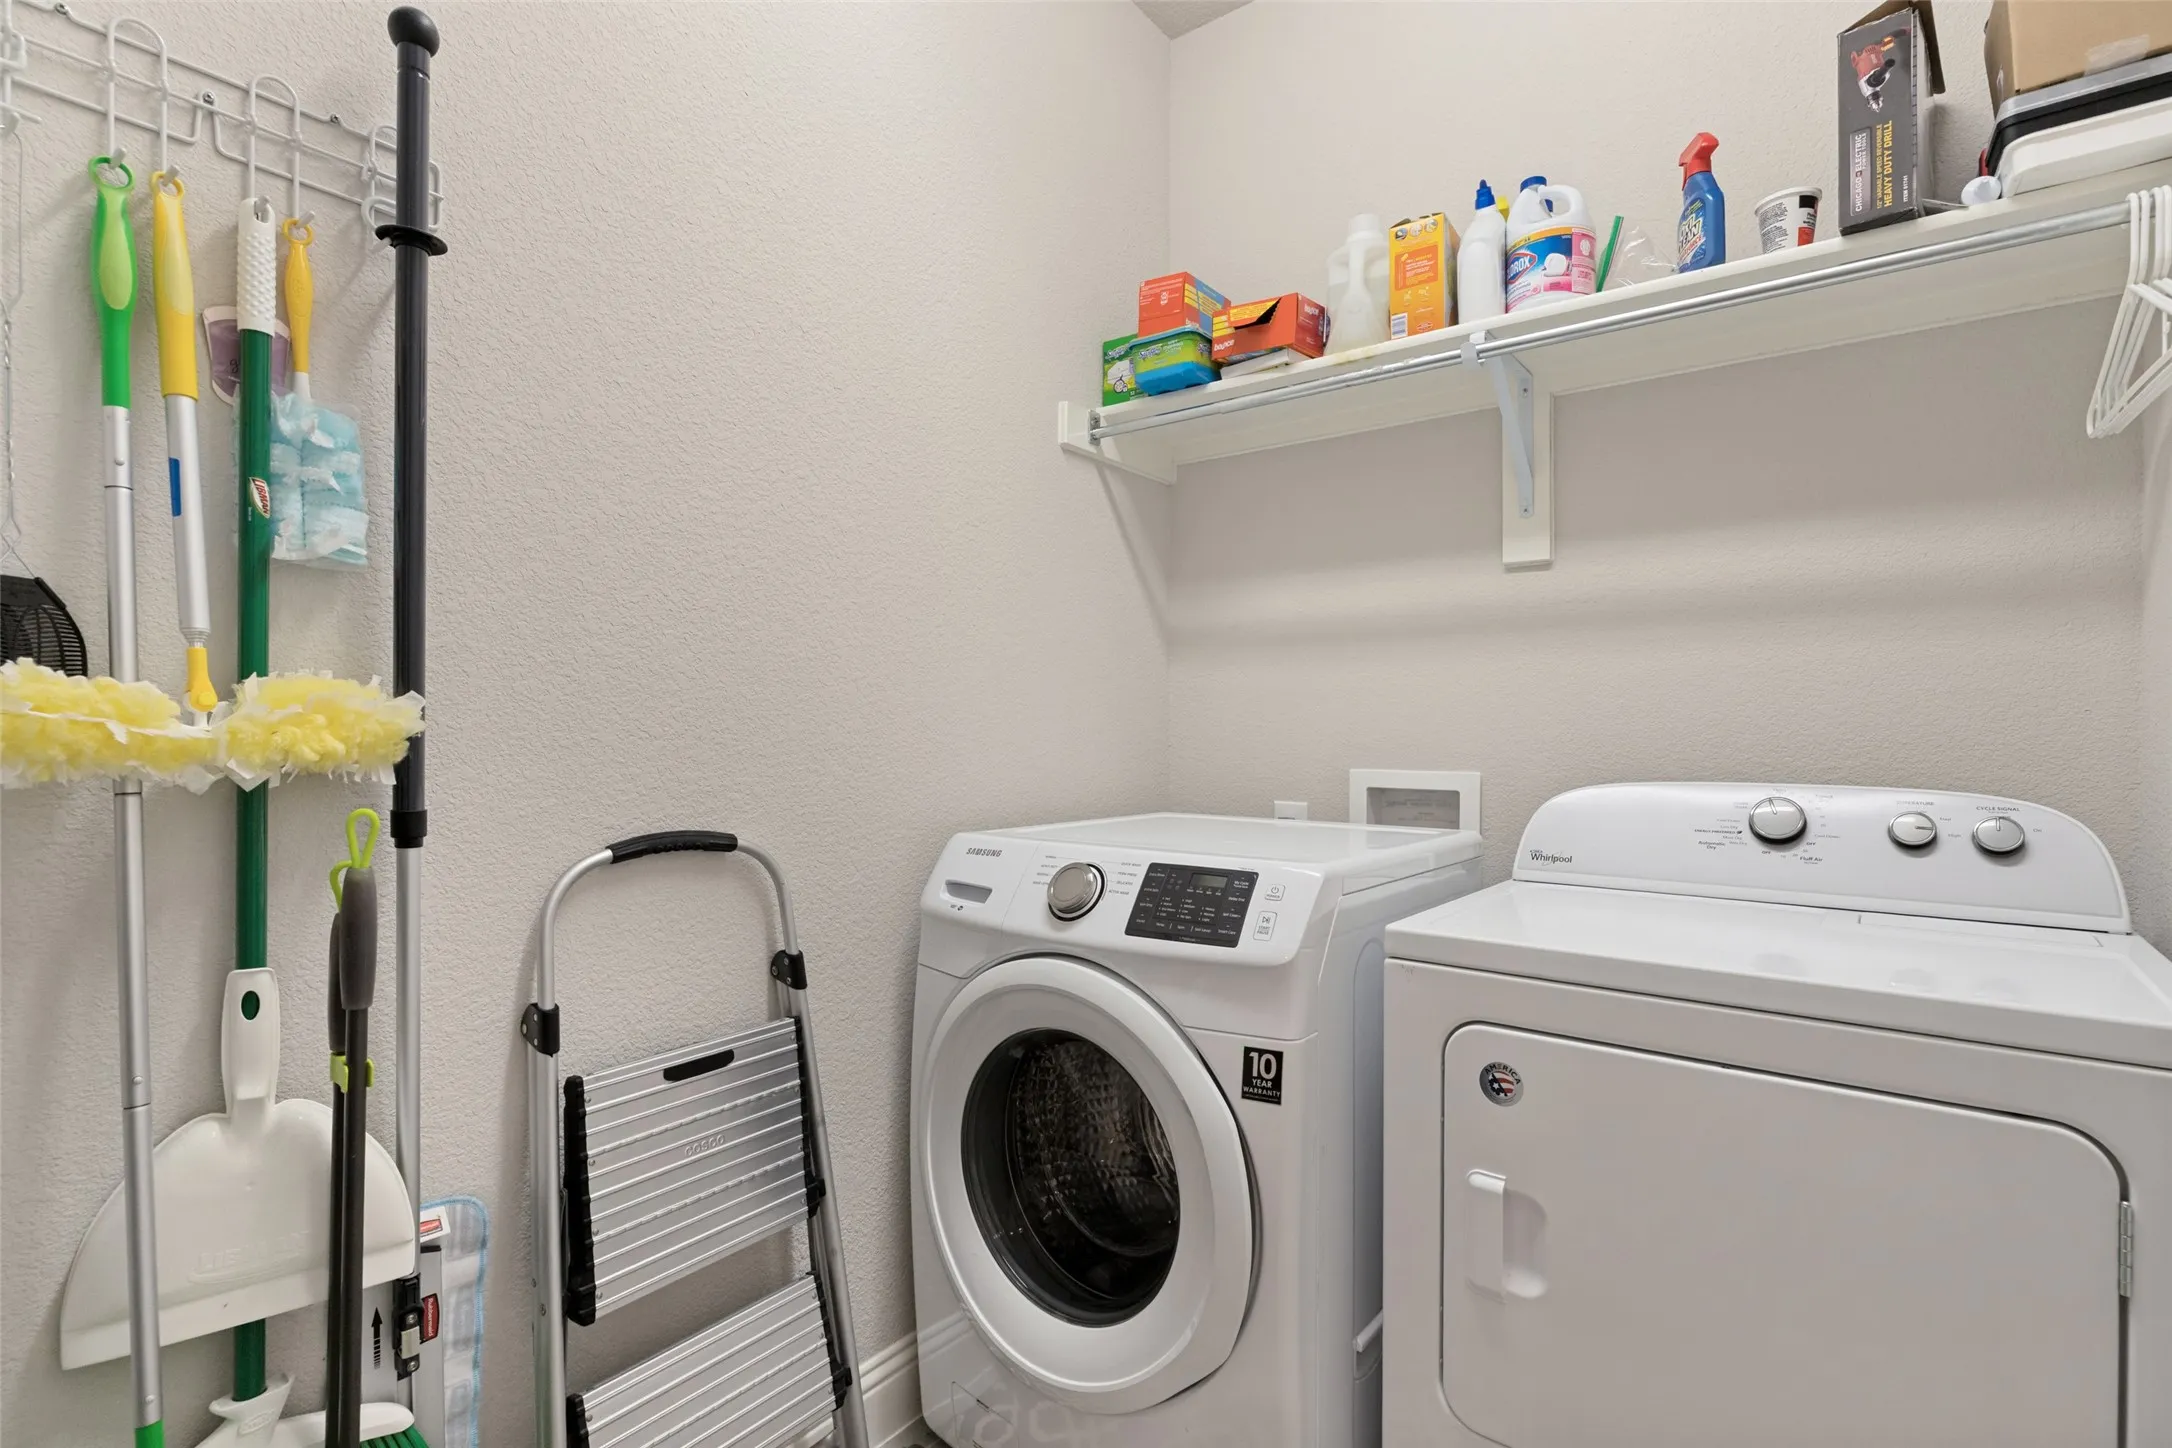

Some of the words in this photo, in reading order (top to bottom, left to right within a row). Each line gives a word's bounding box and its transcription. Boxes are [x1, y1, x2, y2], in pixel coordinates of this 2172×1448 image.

[1884, 120, 1892, 148] DRILL
[1884, 149, 1892, 175] DUTY
[1884, 177, 1892, 206] HEAVY
[1507, 256, 1531, 279] OROX
[1214, 340, 1235, 351] bounce
[252, 478, 269, 514] LIBMAN
[966, 848, 1002, 857] SAMSUNG
[1531, 853, 1572, 864] Whirlpool
[1249, 1051, 1277, 1080] 10
[1485, 1064, 1521, 1084] AMERICA
[1243, 1086, 1280, 1098] WARRANTY
[1252, 1078, 1272, 1088] YEAR
